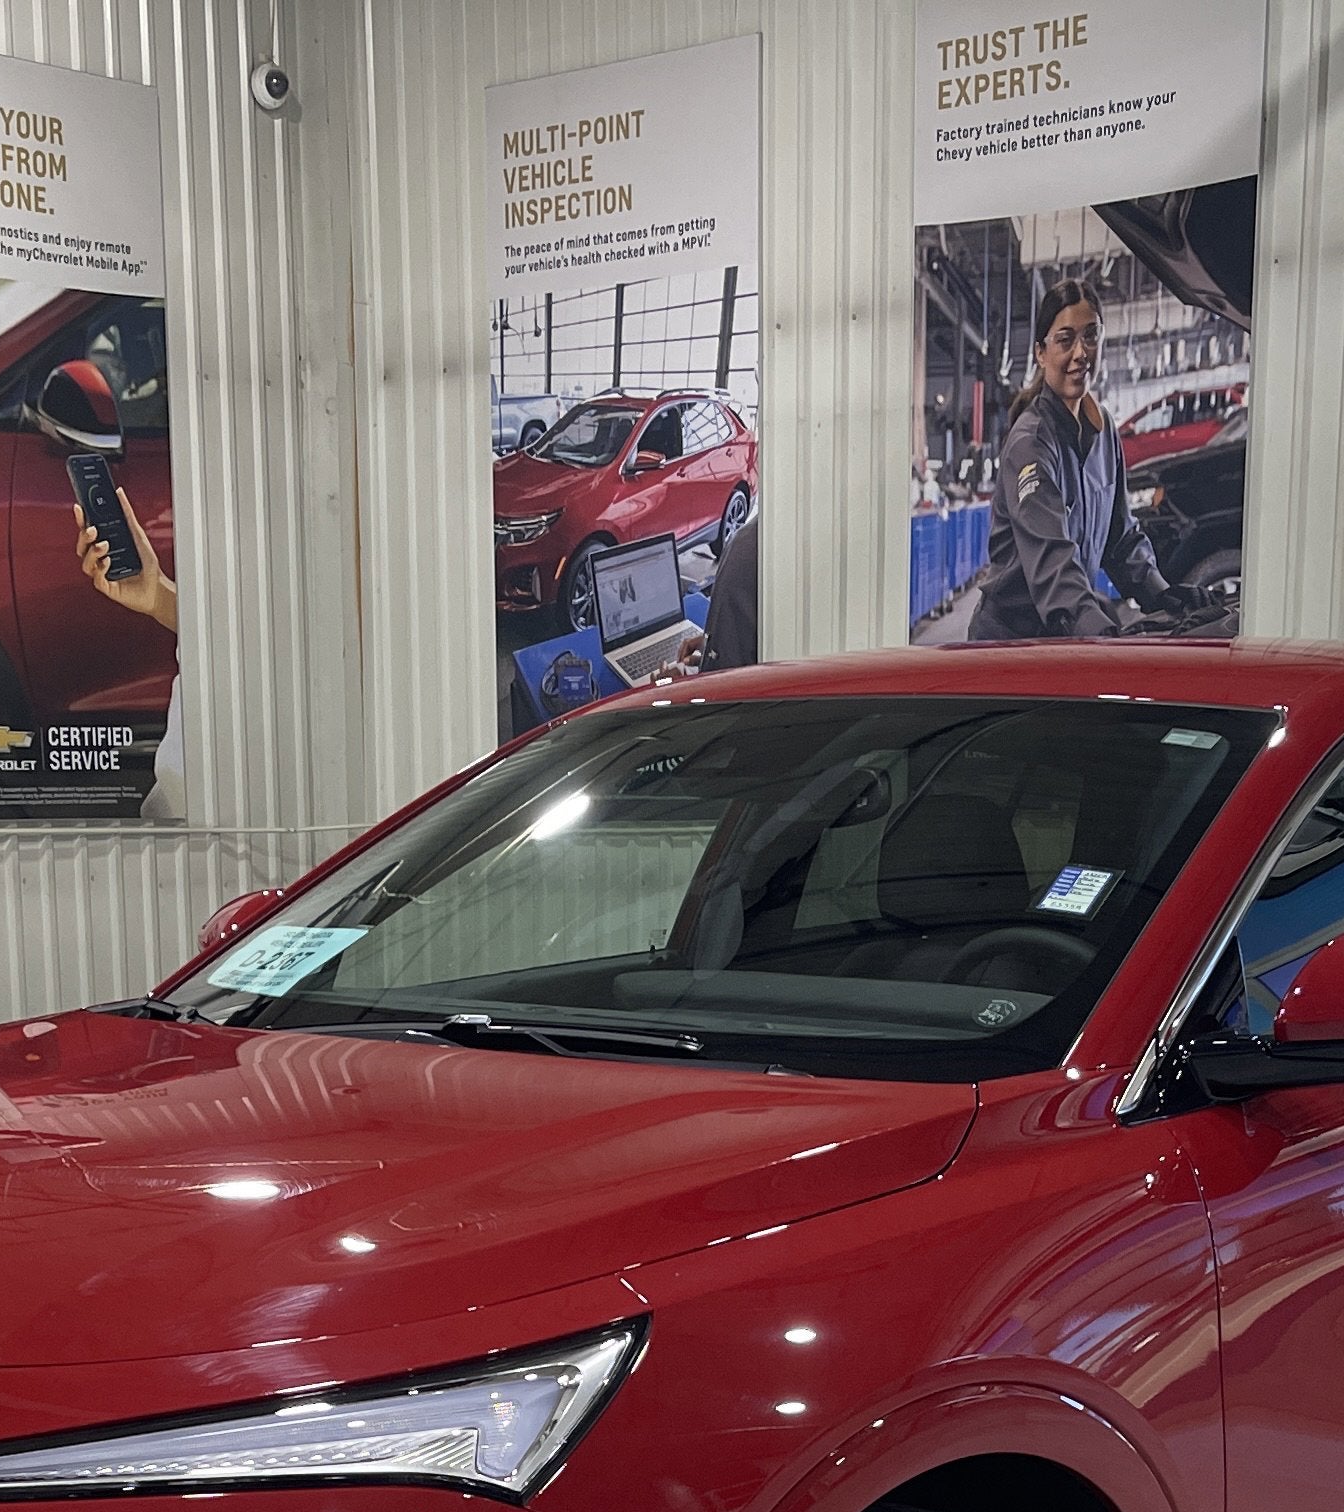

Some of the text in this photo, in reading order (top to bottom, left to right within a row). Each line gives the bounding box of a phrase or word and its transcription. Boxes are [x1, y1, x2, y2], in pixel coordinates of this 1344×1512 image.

[937, 14, 1088, 71] TRUST THE
[938, 60, 1070, 110] EXPERTS.
[0, 107, 64, 146] YOUR
[503, 109, 645, 160] MULTI-POINT
[936, 91, 1177, 143] Factory trained technicians know your
[936, 118, 1146, 163] Chevy vehicle better than anyone.
[1, 144, 68, 182] FROM
[503, 154, 594, 195] VEHICLE
[504, 183, 633, 230] INSPECTION
[42, 232, 62, 247] and
[64, 236, 92, 253] enjoy
[94, 240, 131, 256] remote
[504, 216, 716, 260] The peace of mind that comes from getting
[16, 246, 84, 267] myChevrolet
[86, 256, 118, 272] Mobile
[504, 263, 526, 280] your
[528, 254, 569, 272] vehicle's
[571, 248, 602, 267] health
[605, 242, 645, 263] checked
[648, 240, 670, 257] with
[673, 241, 679, 253] a
[48, 726, 134, 748] CERTIFIED
[49, 750, 120, 771] SERVICE
[240, 950, 316, 971] D-2367
